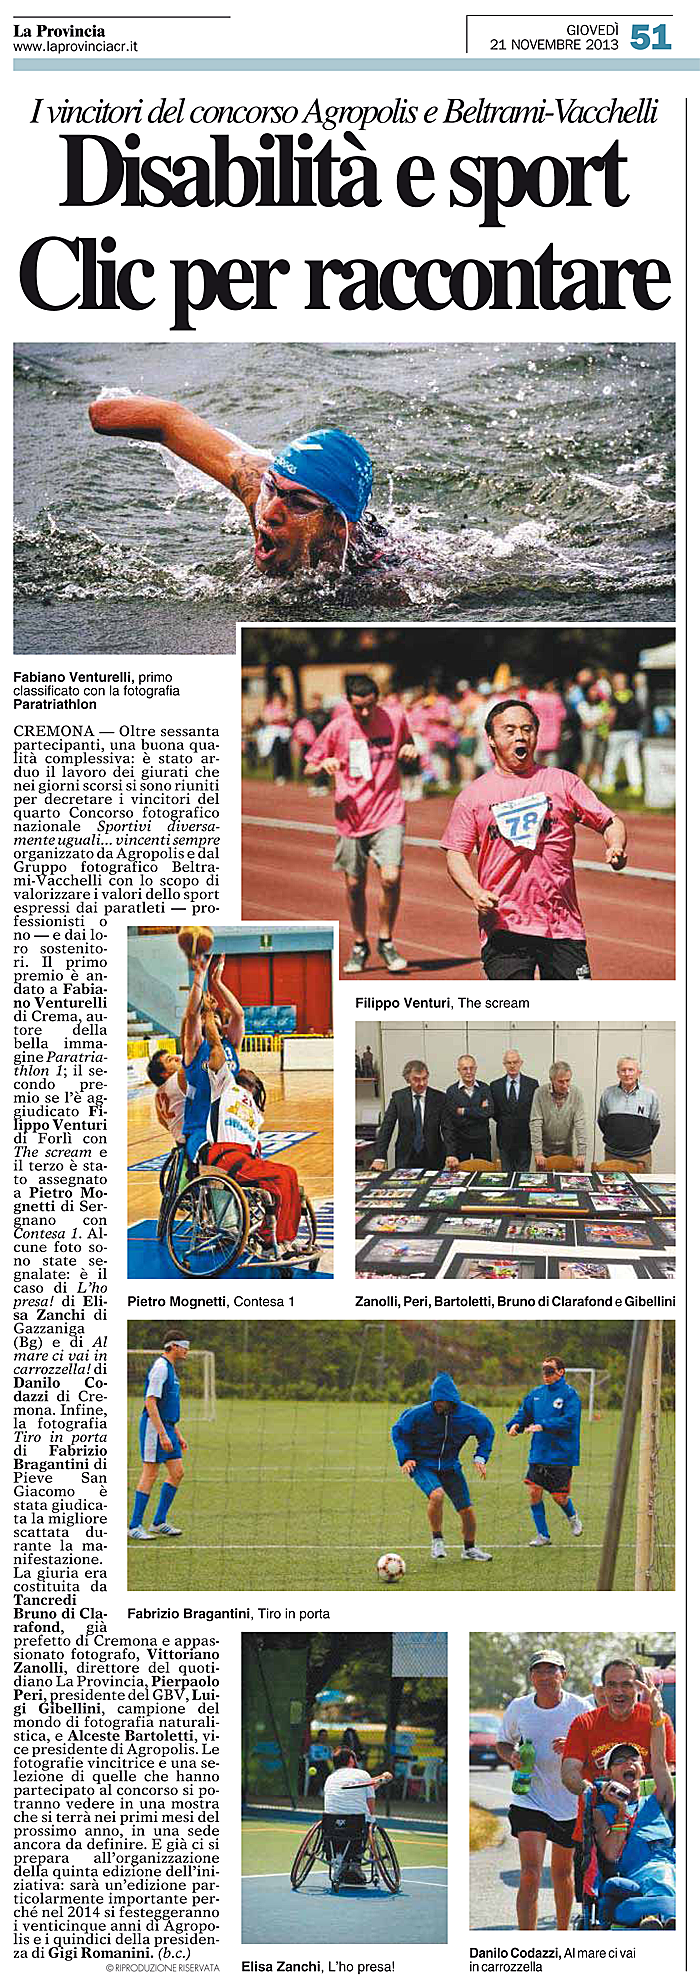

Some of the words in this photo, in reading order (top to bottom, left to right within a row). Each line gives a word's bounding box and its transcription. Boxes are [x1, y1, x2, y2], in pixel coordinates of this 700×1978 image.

[13, 25, 32, 37] La
[36, 25, 105, 37] Provincia
[567, 22, 618, 35] GIOVEDÌ
[630, 24, 671, 50] 51
[13, 41, 138, 54] www.laprovinciacr.it
[490, 39, 506, 50] 21
[512, 39, 581, 50] NOVEMBRE
[586, 39, 618, 50] 2013
[30, 99, 44, 123] I
[47, 99, 143, 123] vincitori
[148, 98, 185, 123] del
[190, 106, 298, 123] concorso
[301, 98, 418, 132] Agropolis
[424, 106, 438, 123] e
[443, 98, 659, 123] Beltrami-Vacchelli
[59, 133, 382, 207] Disabilità
[397, 156, 435, 207] e
[450, 139, 630, 227] sport
[20, 236, 156, 311] Clic
[170, 259, 290, 331] per
[304, 243, 671, 311] raccontare
[14, 672, 65, 682] Fabiano
[69, 672, 134, 684] Venturelli,
[139, 672, 172, 684] primo
[13, 685, 79, 696] classificato
[84, 688, 105, 696] con
[110, 685, 119, 696] la
[124, 685, 180, 699] fotografia
[14, 698, 97, 709] Paratriathlon
[14, 725, 95, 736] CREMONA
[119, 725, 155, 736] Oltre
[161, 725, 219, 736] sessanta
[14, 739, 104, 753] partecipanti,
[110, 741, 135, 750] una
[142, 739, 184, 750] buona
[189, 741, 219, 753] qua-
[13, 752, 37, 763] lità
[45, 752, 134, 766] complessiva:
[143, 752, 150, 763] è
[159, 752, 193, 763] stato
[201, 754, 219, 763] ar-
[14, 766, 39, 777] duo
[46, 766, 55, 777] il
[62, 766, 106, 777] lavoro
[113, 766, 134, 777] dei
[142, 766, 188, 780] giurati
[195, 766, 219, 777] che
[14, 780, 35, 791] nei
[39, 780, 80, 794] giorni
[83, 780, 122, 791] scorsi
[126, 780, 136, 791] si
[140, 782, 171, 791] sono
[175, 780, 219, 791] riuniti
[14, 795, 37, 807] per
[45, 793, 112, 804] decretare
[119, 793, 124, 804] i
[131, 793, 190, 804] vincitori
[198, 793, 219, 804] del
[14, 807, 60, 821] quarto
[69, 807, 133, 818] Concorso
[143, 807, 219, 821] fotografico
[505, 812, 538, 837] 78
[14, 956, 28, 967] ri.
[42, 956, 52, 967] Il
[66, 956, 107, 970] primo
[13, 999, 30, 1008] no
[36, 997, 107, 1008] Venturelli
[356, 997, 400, 1011] Filippo
[404, 997, 453, 1010] Venturi,
[458, 998, 481, 1008] The
[485, 1000, 529, 1008] scream
[14, 1010, 27, 1021] di
[32, 1010, 82, 1024] Crema,
[86, 1012, 107, 1021] au-
[14, 1119, 49, 1133] lippo
[54, 1119, 107, 1130] Venturi
[14, 1132, 27, 1143] di
[38, 1132, 72, 1143] Forlì
[83, 1134, 107, 1143] con
[128, 1296, 165, 1307] Pietro
[170, 1296, 229, 1309] Mognetti,
[234, 1296, 284, 1307] Contesa
[289, 1296, 293, 1306] 1
[355, 1296, 400, 1308] Zanolli,
[404, 1296, 431, 1308] Peri,
[435, 1296, 494, 1308] Bartoletti,
[498, 1296, 535, 1307] Bruno
[538, 1296, 549, 1306] di
[552, 1296, 612, 1307] Clarafond
[615, 1299, 622, 1307] e
[625, 1296, 675, 1307] Gibellini
[13, 1311, 28, 1320] sa
[37, 1309, 85, 1320] Zanchi
[94, 1309, 107, 1320] di
[14, 1377, 60, 1388] Danilo
[85, 1377, 107, 1388] Co-
[14, 1417, 26, 1428] la
[38, 1417, 107, 1431] fotografia
[14, 1445, 27, 1456] di
[49, 1445, 107, 1456] Fabrizio
[13, 1472, 52, 1483] Pieve
[82, 1472, 107, 1483] San
[14, 1526, 69, 1537] scattata
[86, 1526, 107, 1537] du-
[128, 1608, 179, 1619] Fabrizio
[184, 1608, 253, 1621] Bragantini,
[258, 1608, 281, 1619] Tiro
[286, 1608, 295, 1619] in
[300, 1609, 330, 1621] porta
[14, 1675, 52, 1686] diano
[56, 1675, 73, 1686] La
[77, 1675, 148, 1689] Provincia,
[152, 1675, 219, 1689] Pierpaolo
[14, 1702, 26, 1716] gi
[39, 1702, 104, 1716] Gibellini,
[117, 1702, 185, 1716] campione
[198, 1702, 219, 1713] del
[14, 1716, 61, 1727] mondo
[66, 1716, 79, 1727] di
[84, 1716, 154, 1730] fotografia
[159, 1716, 219, 1727] naturali-
[14, 1906, 38, 1917] ché
[42, 1906, 63, 1917] nel
[68, 1906, 100, 1917] 2014
[104, 1906, 115, 1917] si
[119, 1906, 219, 1920] festeggeranno
[14, 1949, 28, 1958] za
[32, 1947, 45, 1958] di
[48, 1947, 78, 1961] Gigi
[81, 1947, 153, 1958] Romanini.
[158, 1947, 190, 1961] (b.c.)
[470, 1948, 508, 1958] Danilo
[511, 1947, 561, 1960] Codazzi,
[564, 1948, 575, 1958] Al
[578, 1950, 606, 1958] mare
[609, 1948, 617, 1958] ci
[620, 1948, 635, 1958] vai
[115, 1964, 177, 1972] RIPRODUZIONE
[179, 1964, 220, 1972] RISERVATA
[242, 1961, 272, 1972] Elisa
[277, 1961, 323, 1973] Zanchi,
[329, 1961, 353, 1972] L’ho
[358, 1961, 394, 1974] presa!
[470, 1961, 479, 1972] in
[481, 1961, 542, 1972] carrozzella
